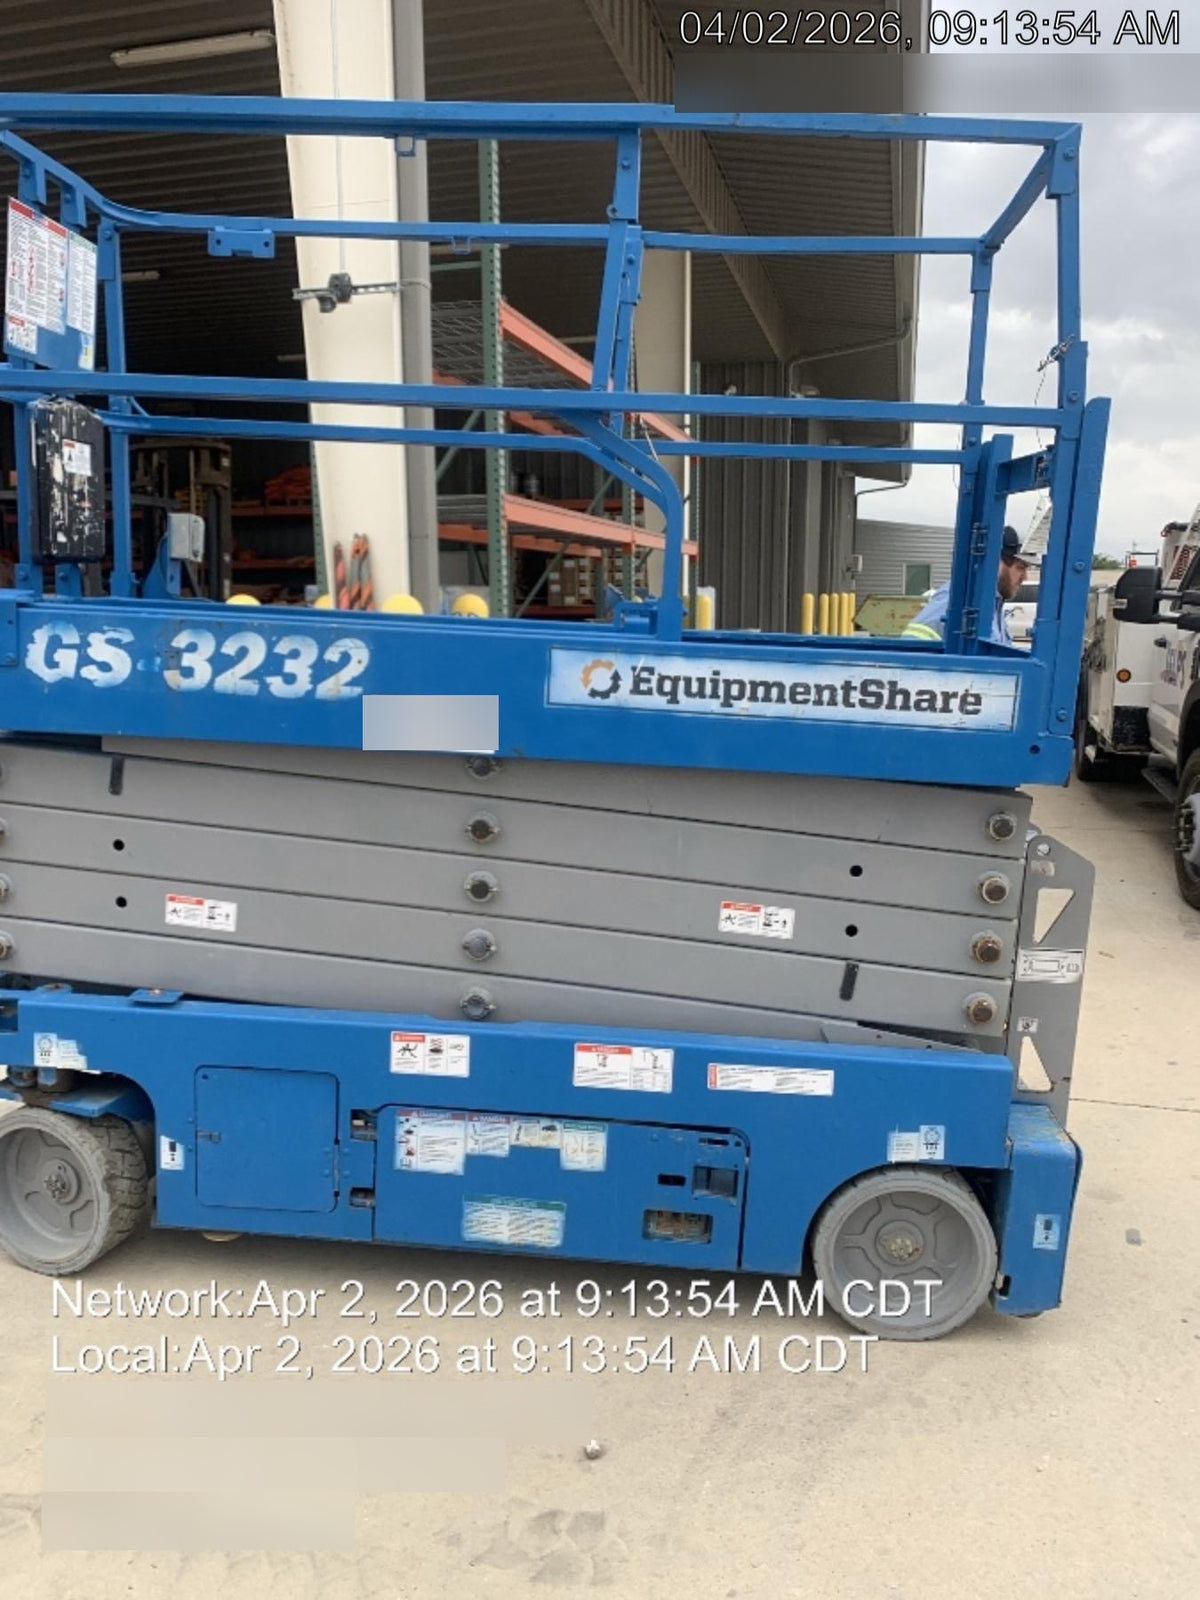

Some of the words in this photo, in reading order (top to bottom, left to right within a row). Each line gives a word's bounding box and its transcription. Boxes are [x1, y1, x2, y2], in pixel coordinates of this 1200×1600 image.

[25, 620, 135, 689] GS
[163, 628, 371, 700] 3232
[629, 665, 984, 715] EquipmentShare
